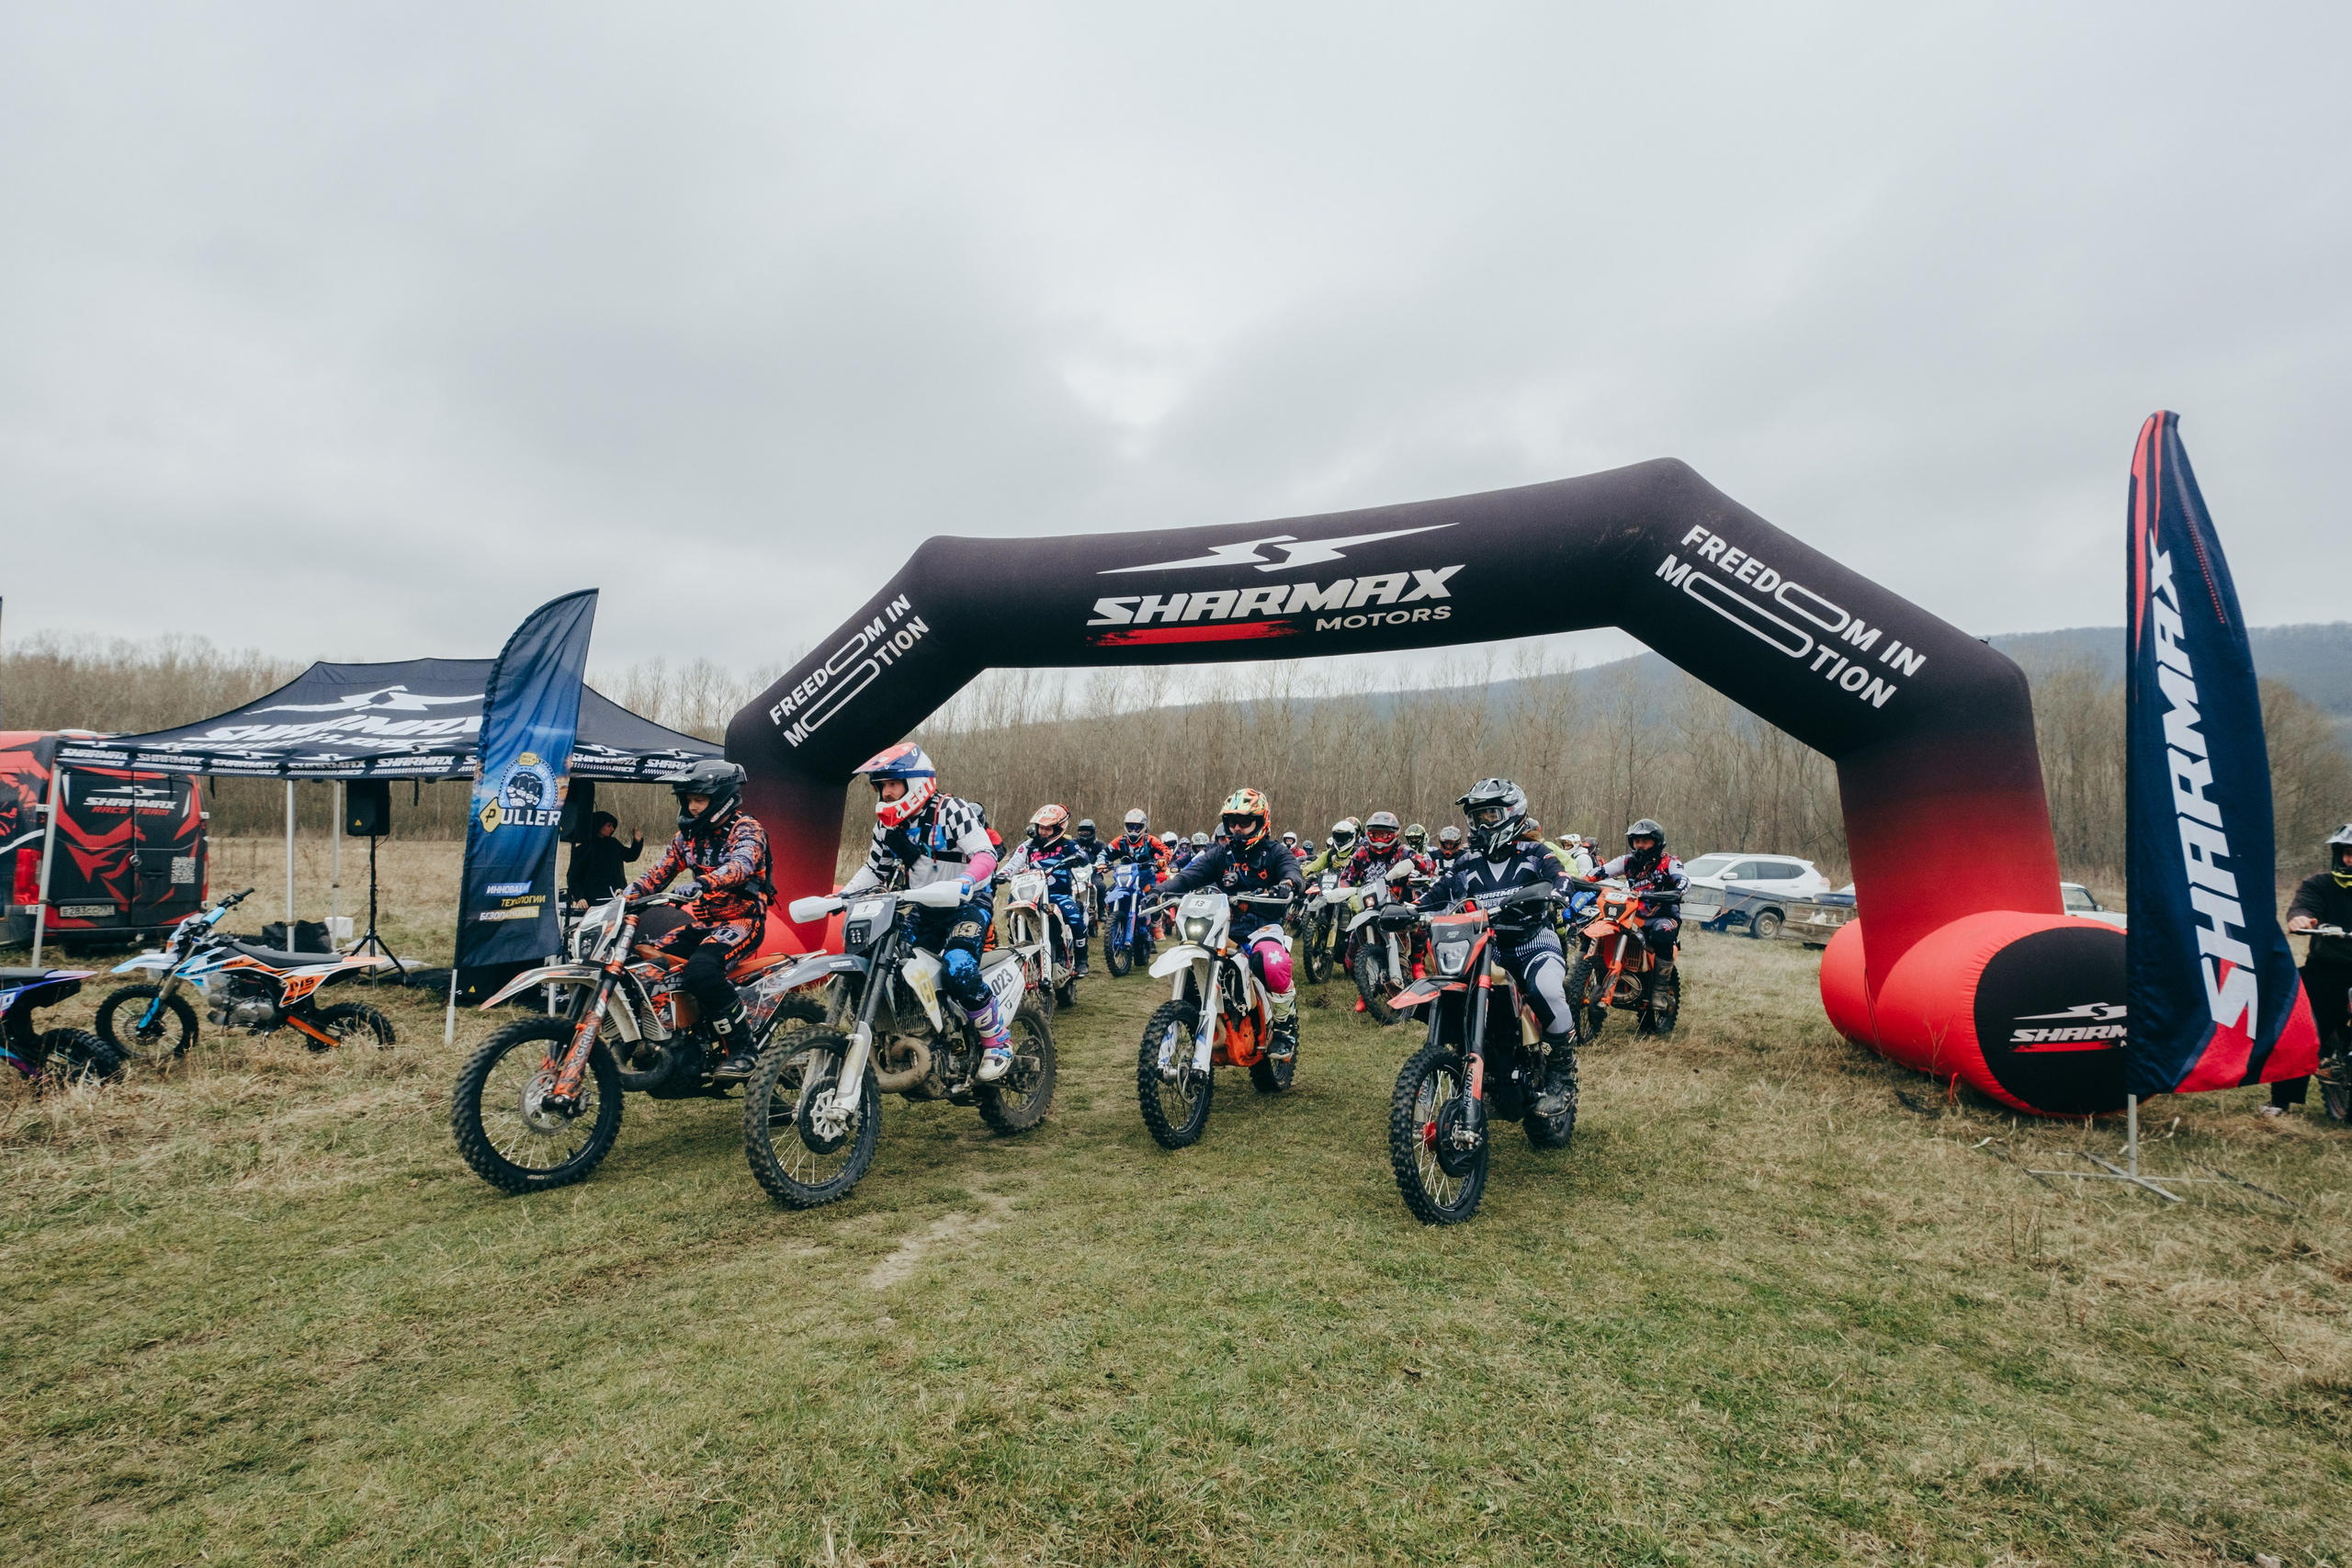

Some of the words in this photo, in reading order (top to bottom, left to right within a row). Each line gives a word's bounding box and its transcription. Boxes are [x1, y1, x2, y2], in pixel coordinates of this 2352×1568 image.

[1086, 564, 1466, 626] SHARMAX
[1680, 525, 1883, 652] FREEDOM
[1879, 640, 1927, 677] IN
[1316, 604, 1452, 632] MOTORS
[1656, 554, 1897, 709] MOTION
[769, 616, 887, 726] FREEDOM
[885, 593, 911, 623] IN
[783, 615, 930, 748] MOTION
[61, 748, 129, 761] SHARMAX
[136, 753, 205, 765] SHARMAX
[377, 755, 457, 767] SHARMAX
[211, 759, 279, 769] SHARMAX
[612, 765, 636, 773] RACE
[2149, 528, 2257, 1041] SHARMAX
[84, 796, 177, 810] SHARMAX
[92, 807, 130, 815] RACE
[136, 807, 171, 817] TEAM
[1194, 899, 1205, 908] 13
[2009, 1024, 2128, 1042] SHARM
